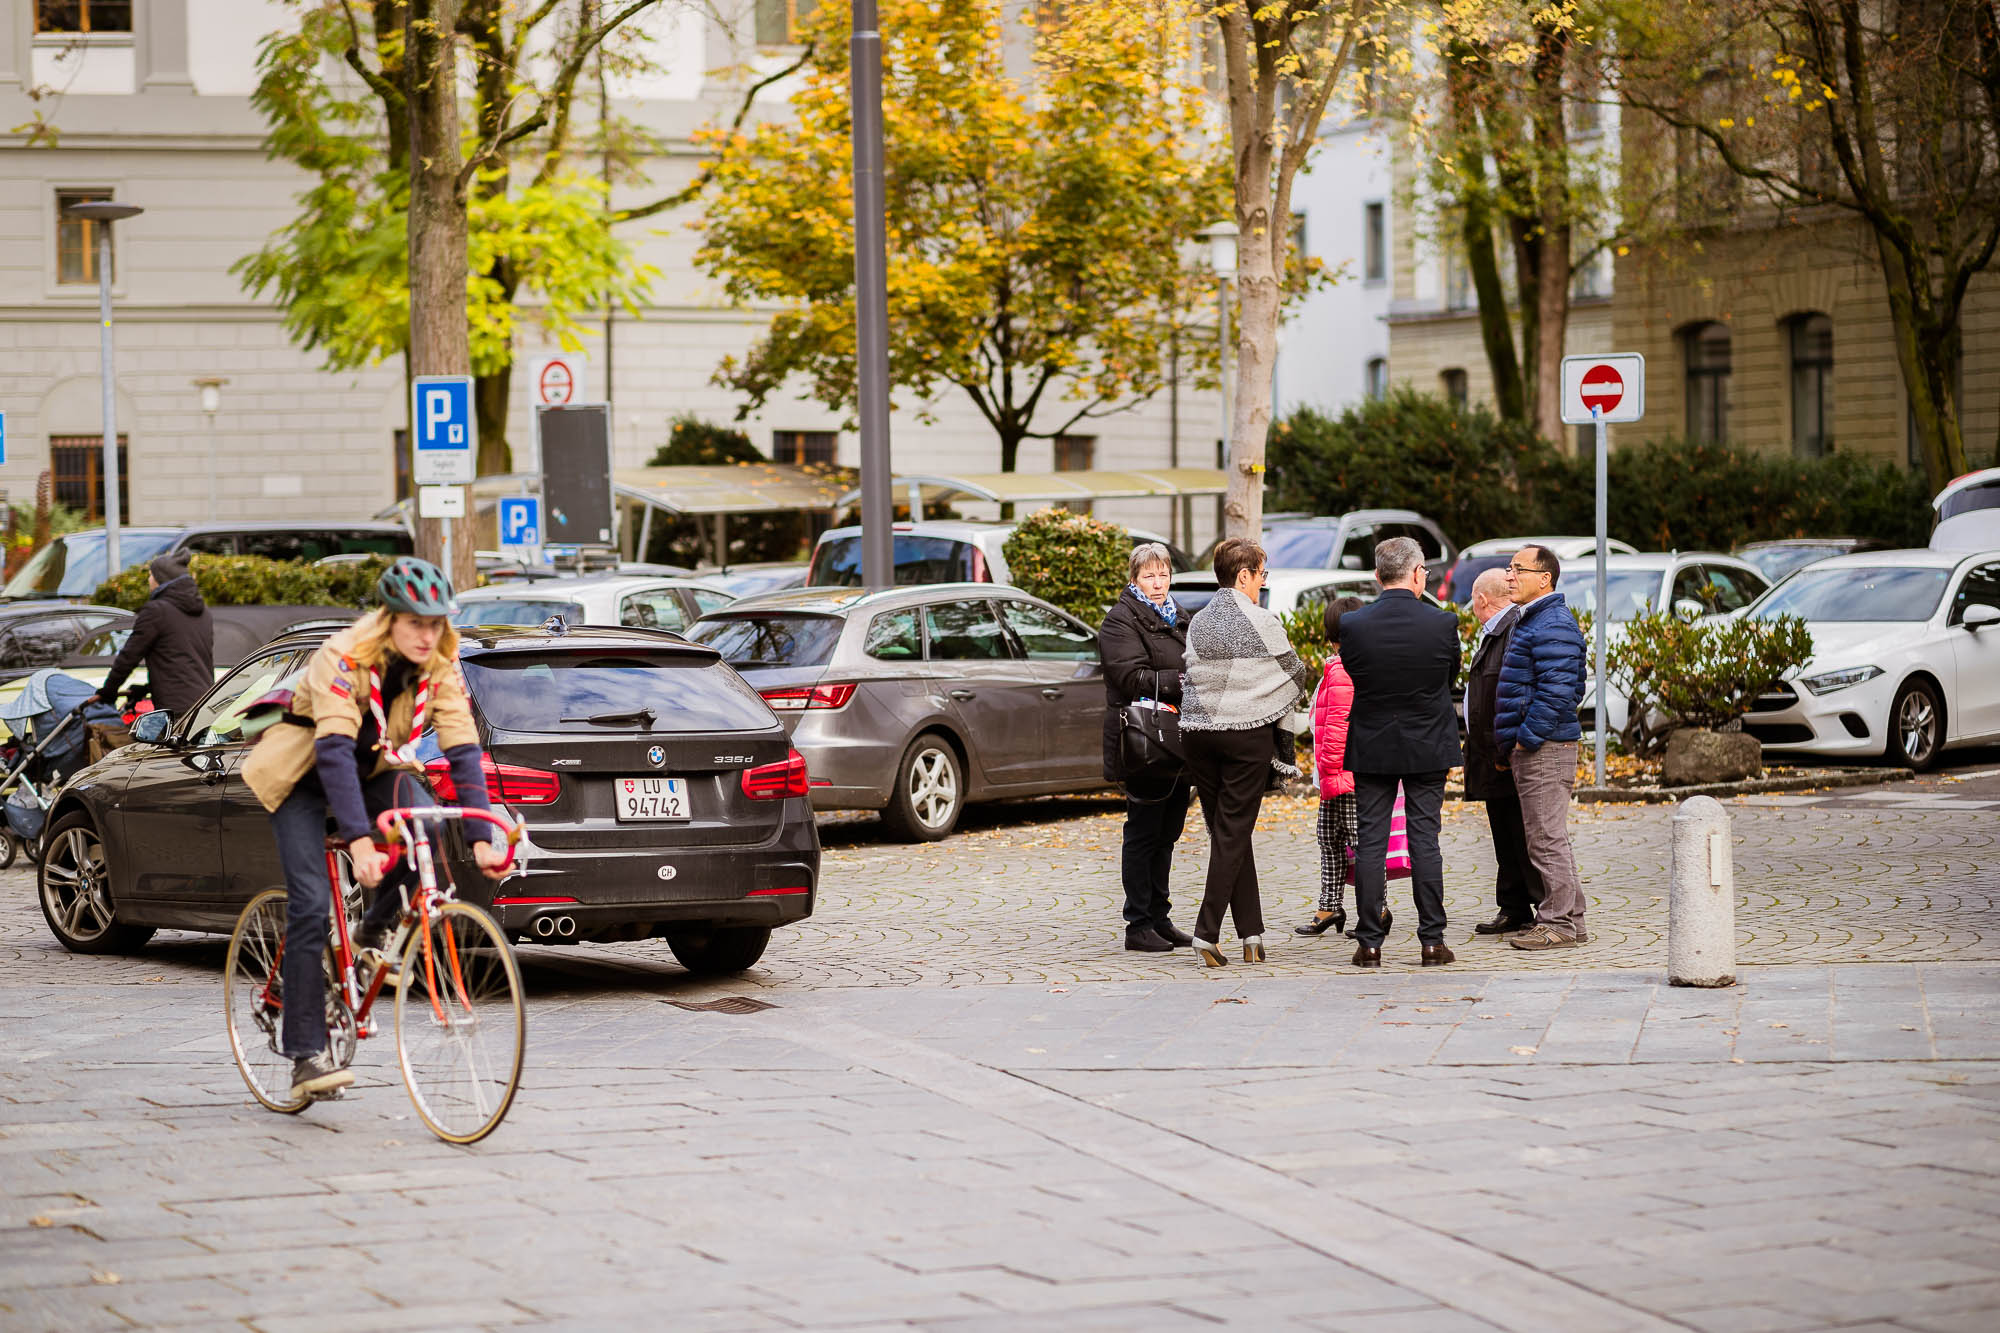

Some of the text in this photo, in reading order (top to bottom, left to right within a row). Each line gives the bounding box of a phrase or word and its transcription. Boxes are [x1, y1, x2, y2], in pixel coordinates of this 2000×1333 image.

[426, 390, 452, 441] P
[510, 505, 528, 538] P
[713, 755, 754, 763] 335d
[643, 780, 661, 794] LU
[628, 797, 681, 817] 94742
[661, 868, 673, 877] CH
